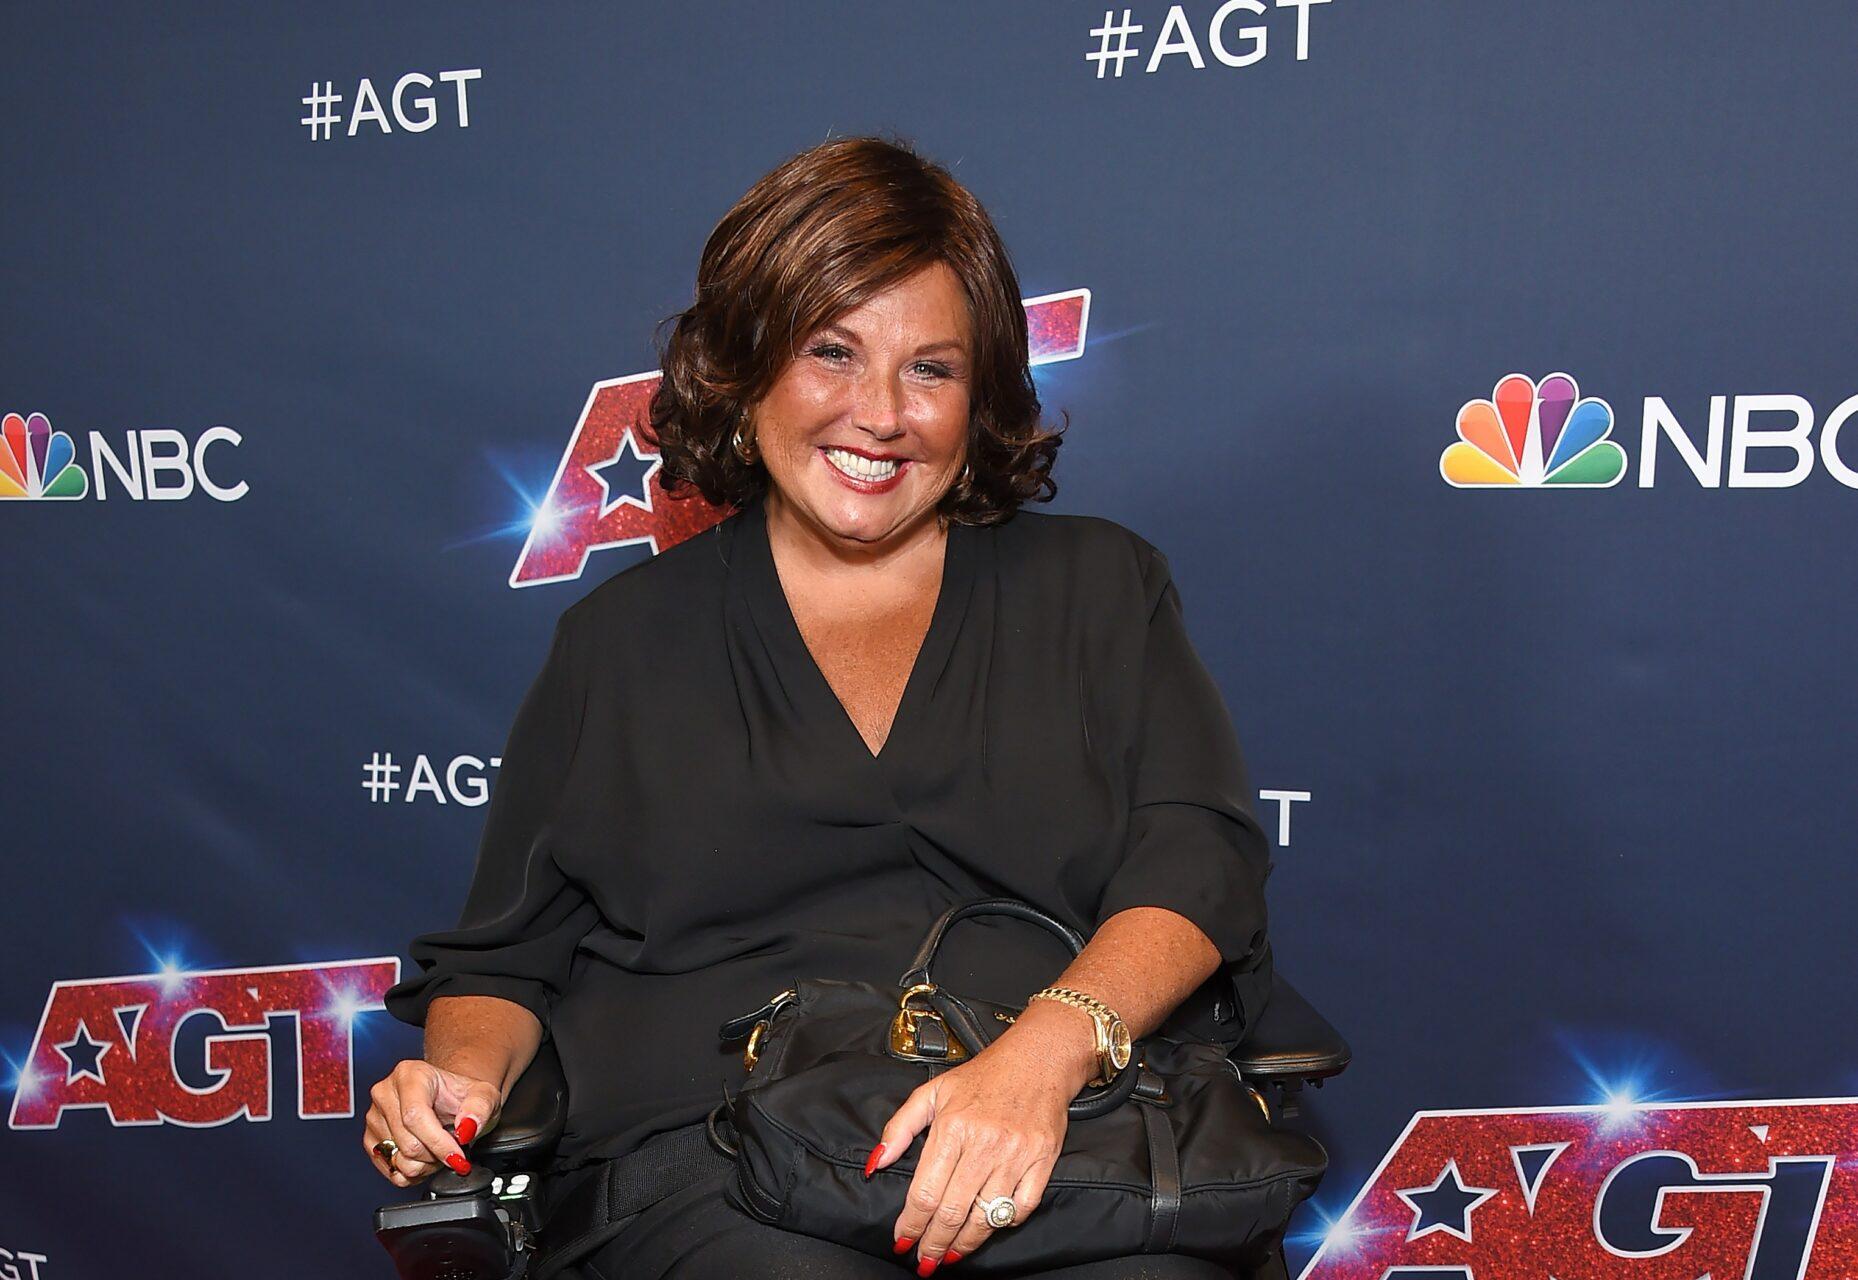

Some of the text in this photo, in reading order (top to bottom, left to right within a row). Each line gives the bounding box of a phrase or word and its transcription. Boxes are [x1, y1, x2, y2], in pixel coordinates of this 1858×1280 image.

[1085, 0, 1333, 79] #AGT
[301, 68, 482, 141] #AGT
[89, 426, 250, 502] NBC
[361, 752, 503, 807] #AG
[8, 956, 401, 1129] AGT
